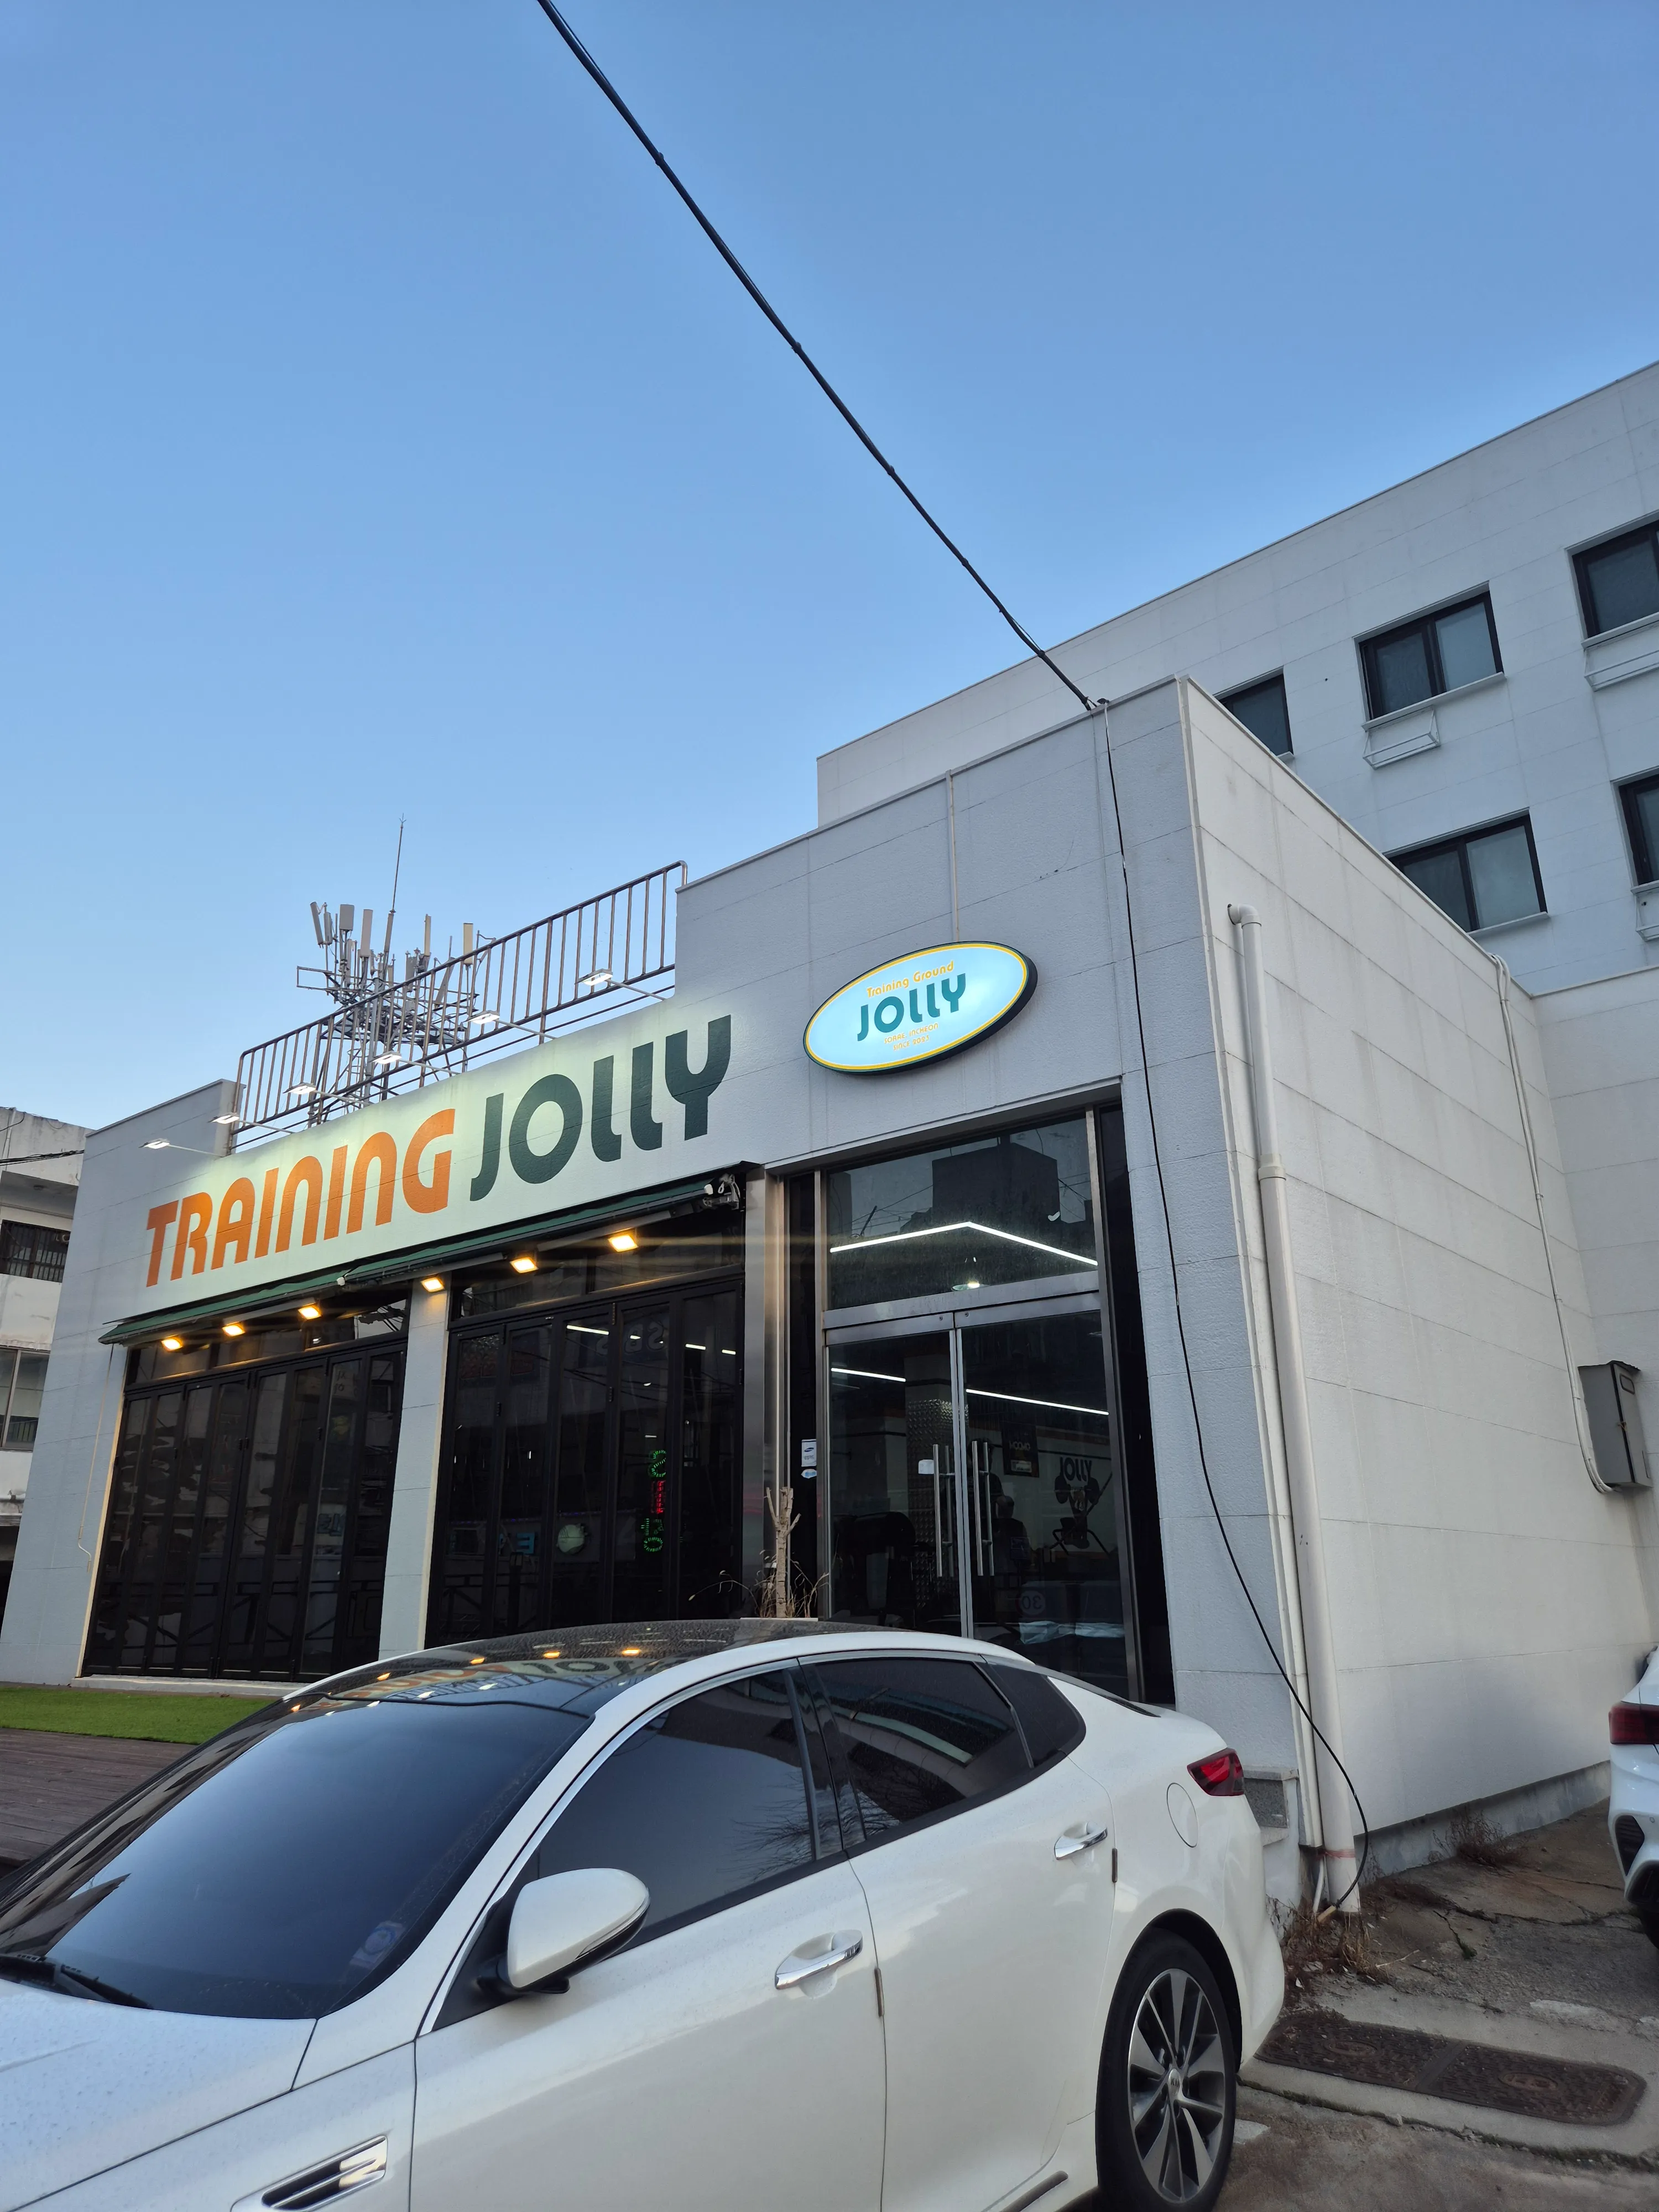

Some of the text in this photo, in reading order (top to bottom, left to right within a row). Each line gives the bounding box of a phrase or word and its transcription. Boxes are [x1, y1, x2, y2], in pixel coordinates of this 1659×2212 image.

[867, 961, 954, 998] Training Ground
[857, 973, 966, 1042] JOLLY
[909, 1022, 938, 1037] INCHEON
[893, 1040, 911, 1051] SINCE
[146, 1014, 732, 1287] TRAINING JOLLY
[1060, 1456, 1092, 1482] JOLLY
[1171, 2077, 1180, 2088] KIA
